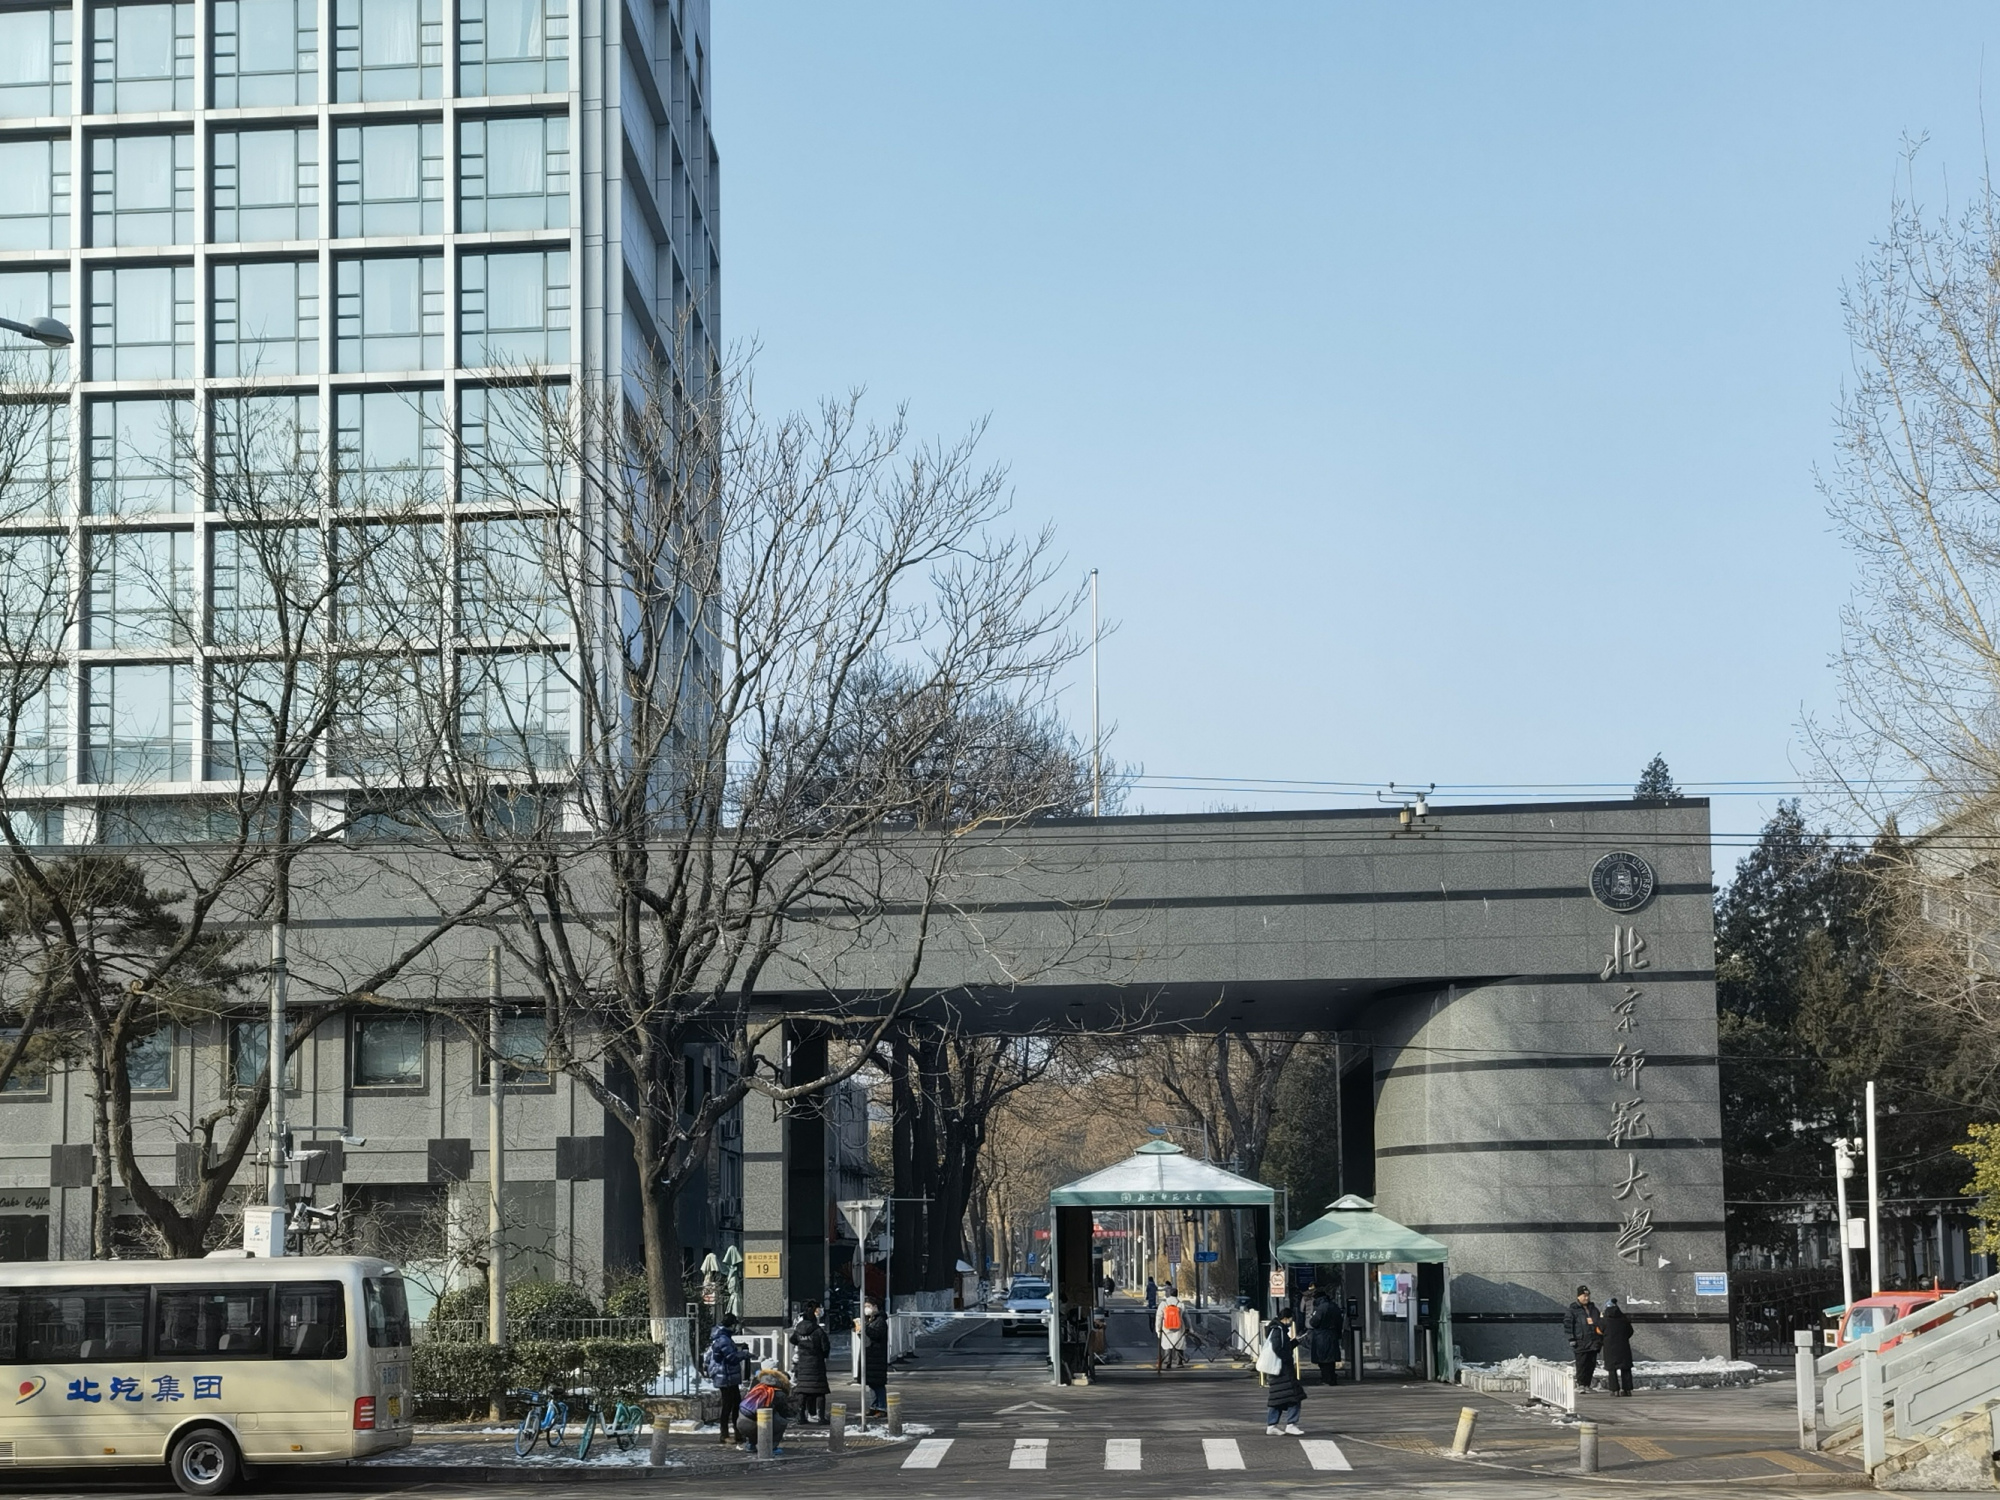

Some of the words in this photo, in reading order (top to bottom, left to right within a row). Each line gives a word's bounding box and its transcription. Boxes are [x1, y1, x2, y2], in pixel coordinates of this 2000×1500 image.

[756, 1263, 770, 1275] 19
[66, 1374, 223, 1404] 北汽集团
